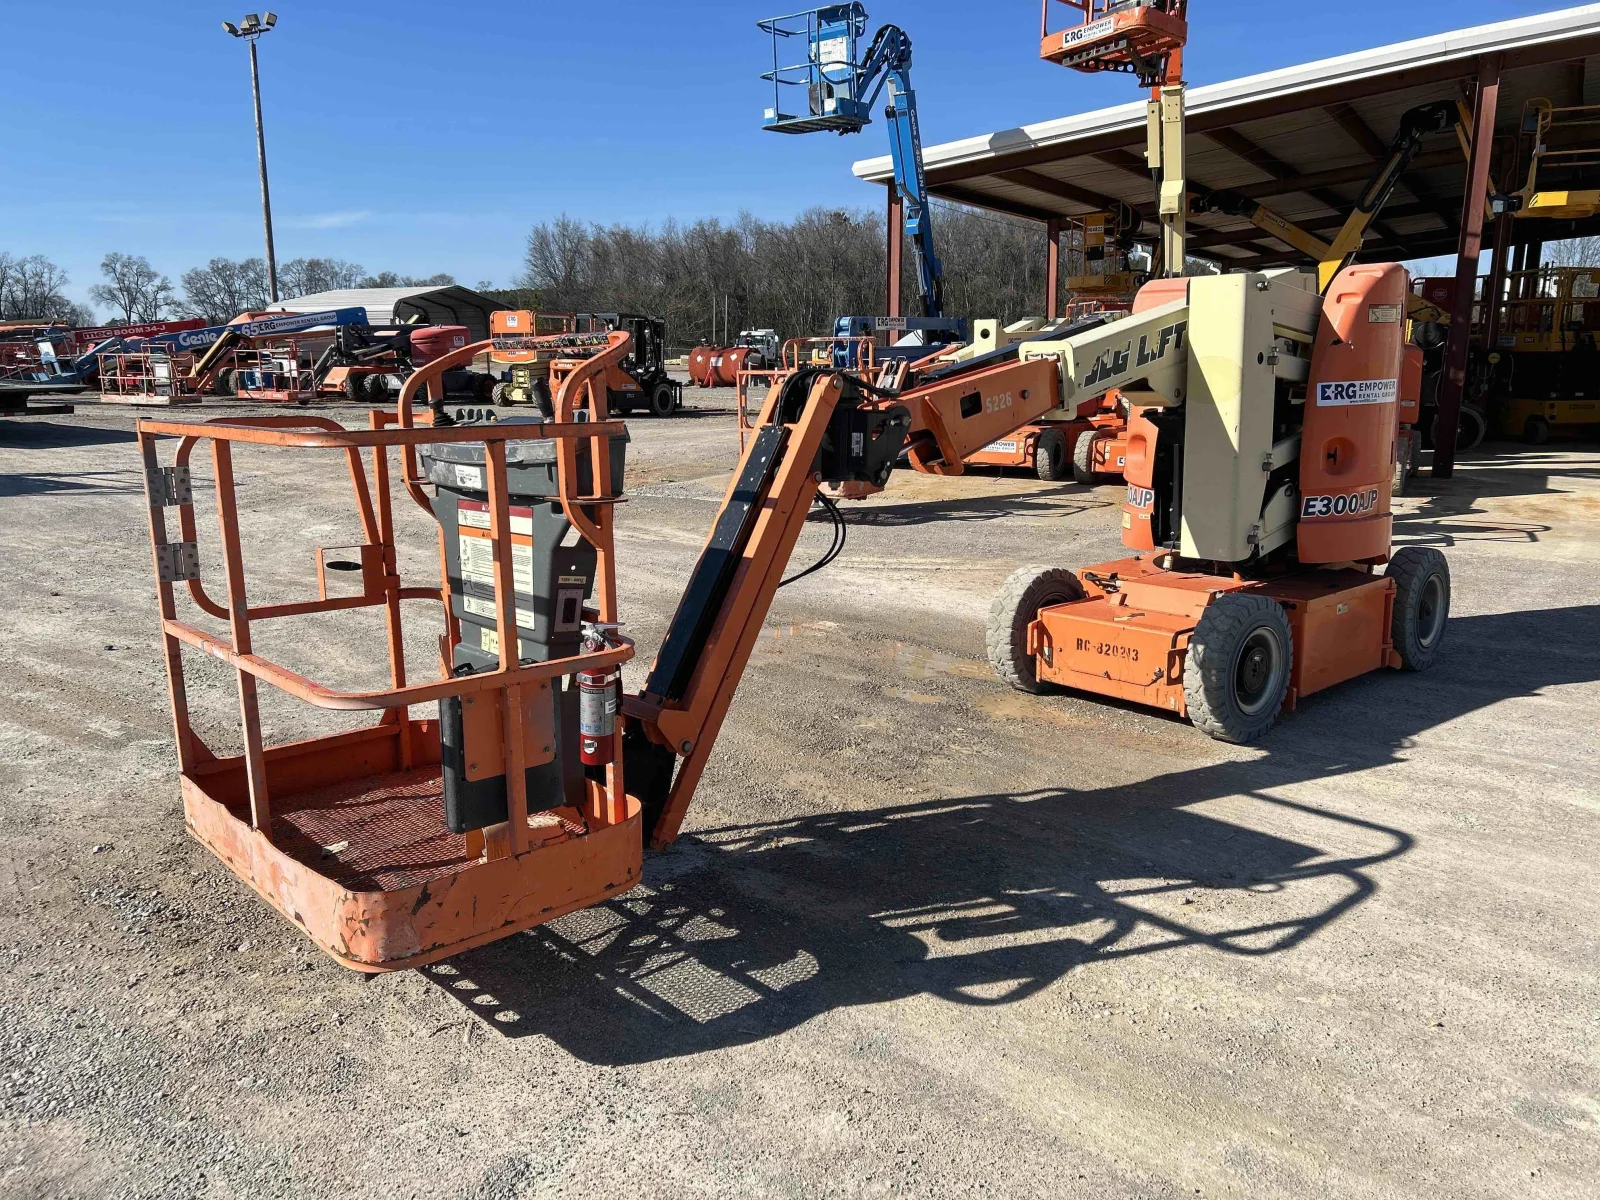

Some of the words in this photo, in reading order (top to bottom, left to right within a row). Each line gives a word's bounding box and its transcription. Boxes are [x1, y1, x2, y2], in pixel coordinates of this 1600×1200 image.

[1064, 29, 1083, 44] ERG
[1083, 19, 1112, 34] EMPOWER
[113, 327, 144, 336] BOOM
[259, 321, 276, 334] ERG
[178, 331, 218, 347] Genie
[1320, 382, 1357, 400] ERG
[1358, 380, 1396, 392] EMPOWER
[986, 391, 1012, 413] 5226
[1301, 488, 1379, 518] E300AJP
